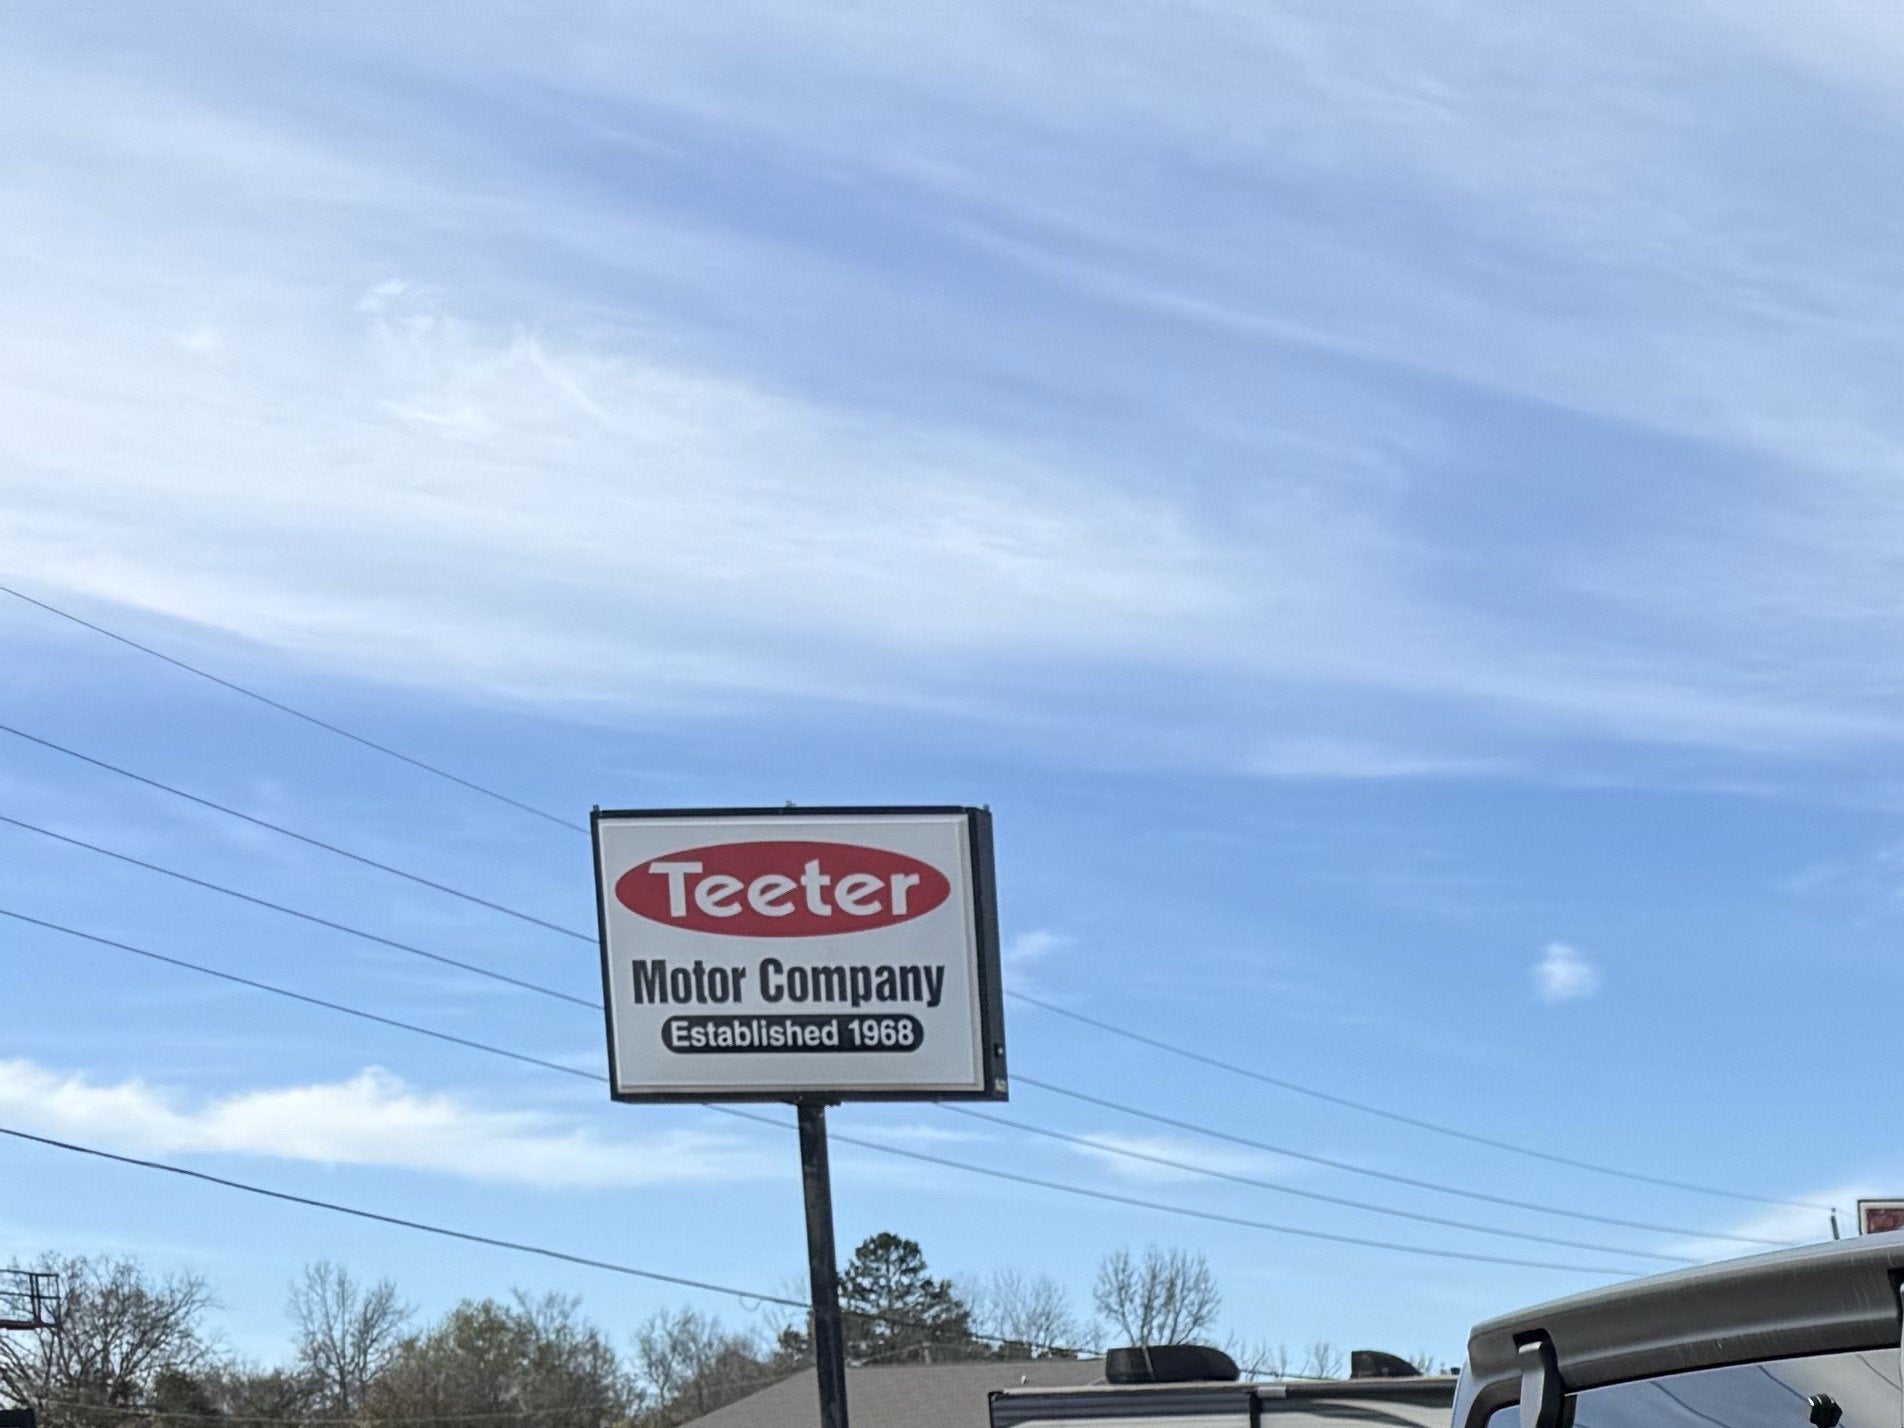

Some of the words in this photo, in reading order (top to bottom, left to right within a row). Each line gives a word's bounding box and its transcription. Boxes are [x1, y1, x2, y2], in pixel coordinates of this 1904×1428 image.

[649, 859, 920, 918] Teeter
[632, 958, 747, 1004] Motor
[759, 957, 945, 1008] Company
[671, 1019, 838, 1048] Established
[848, 1019, 915, 1047] 1968
